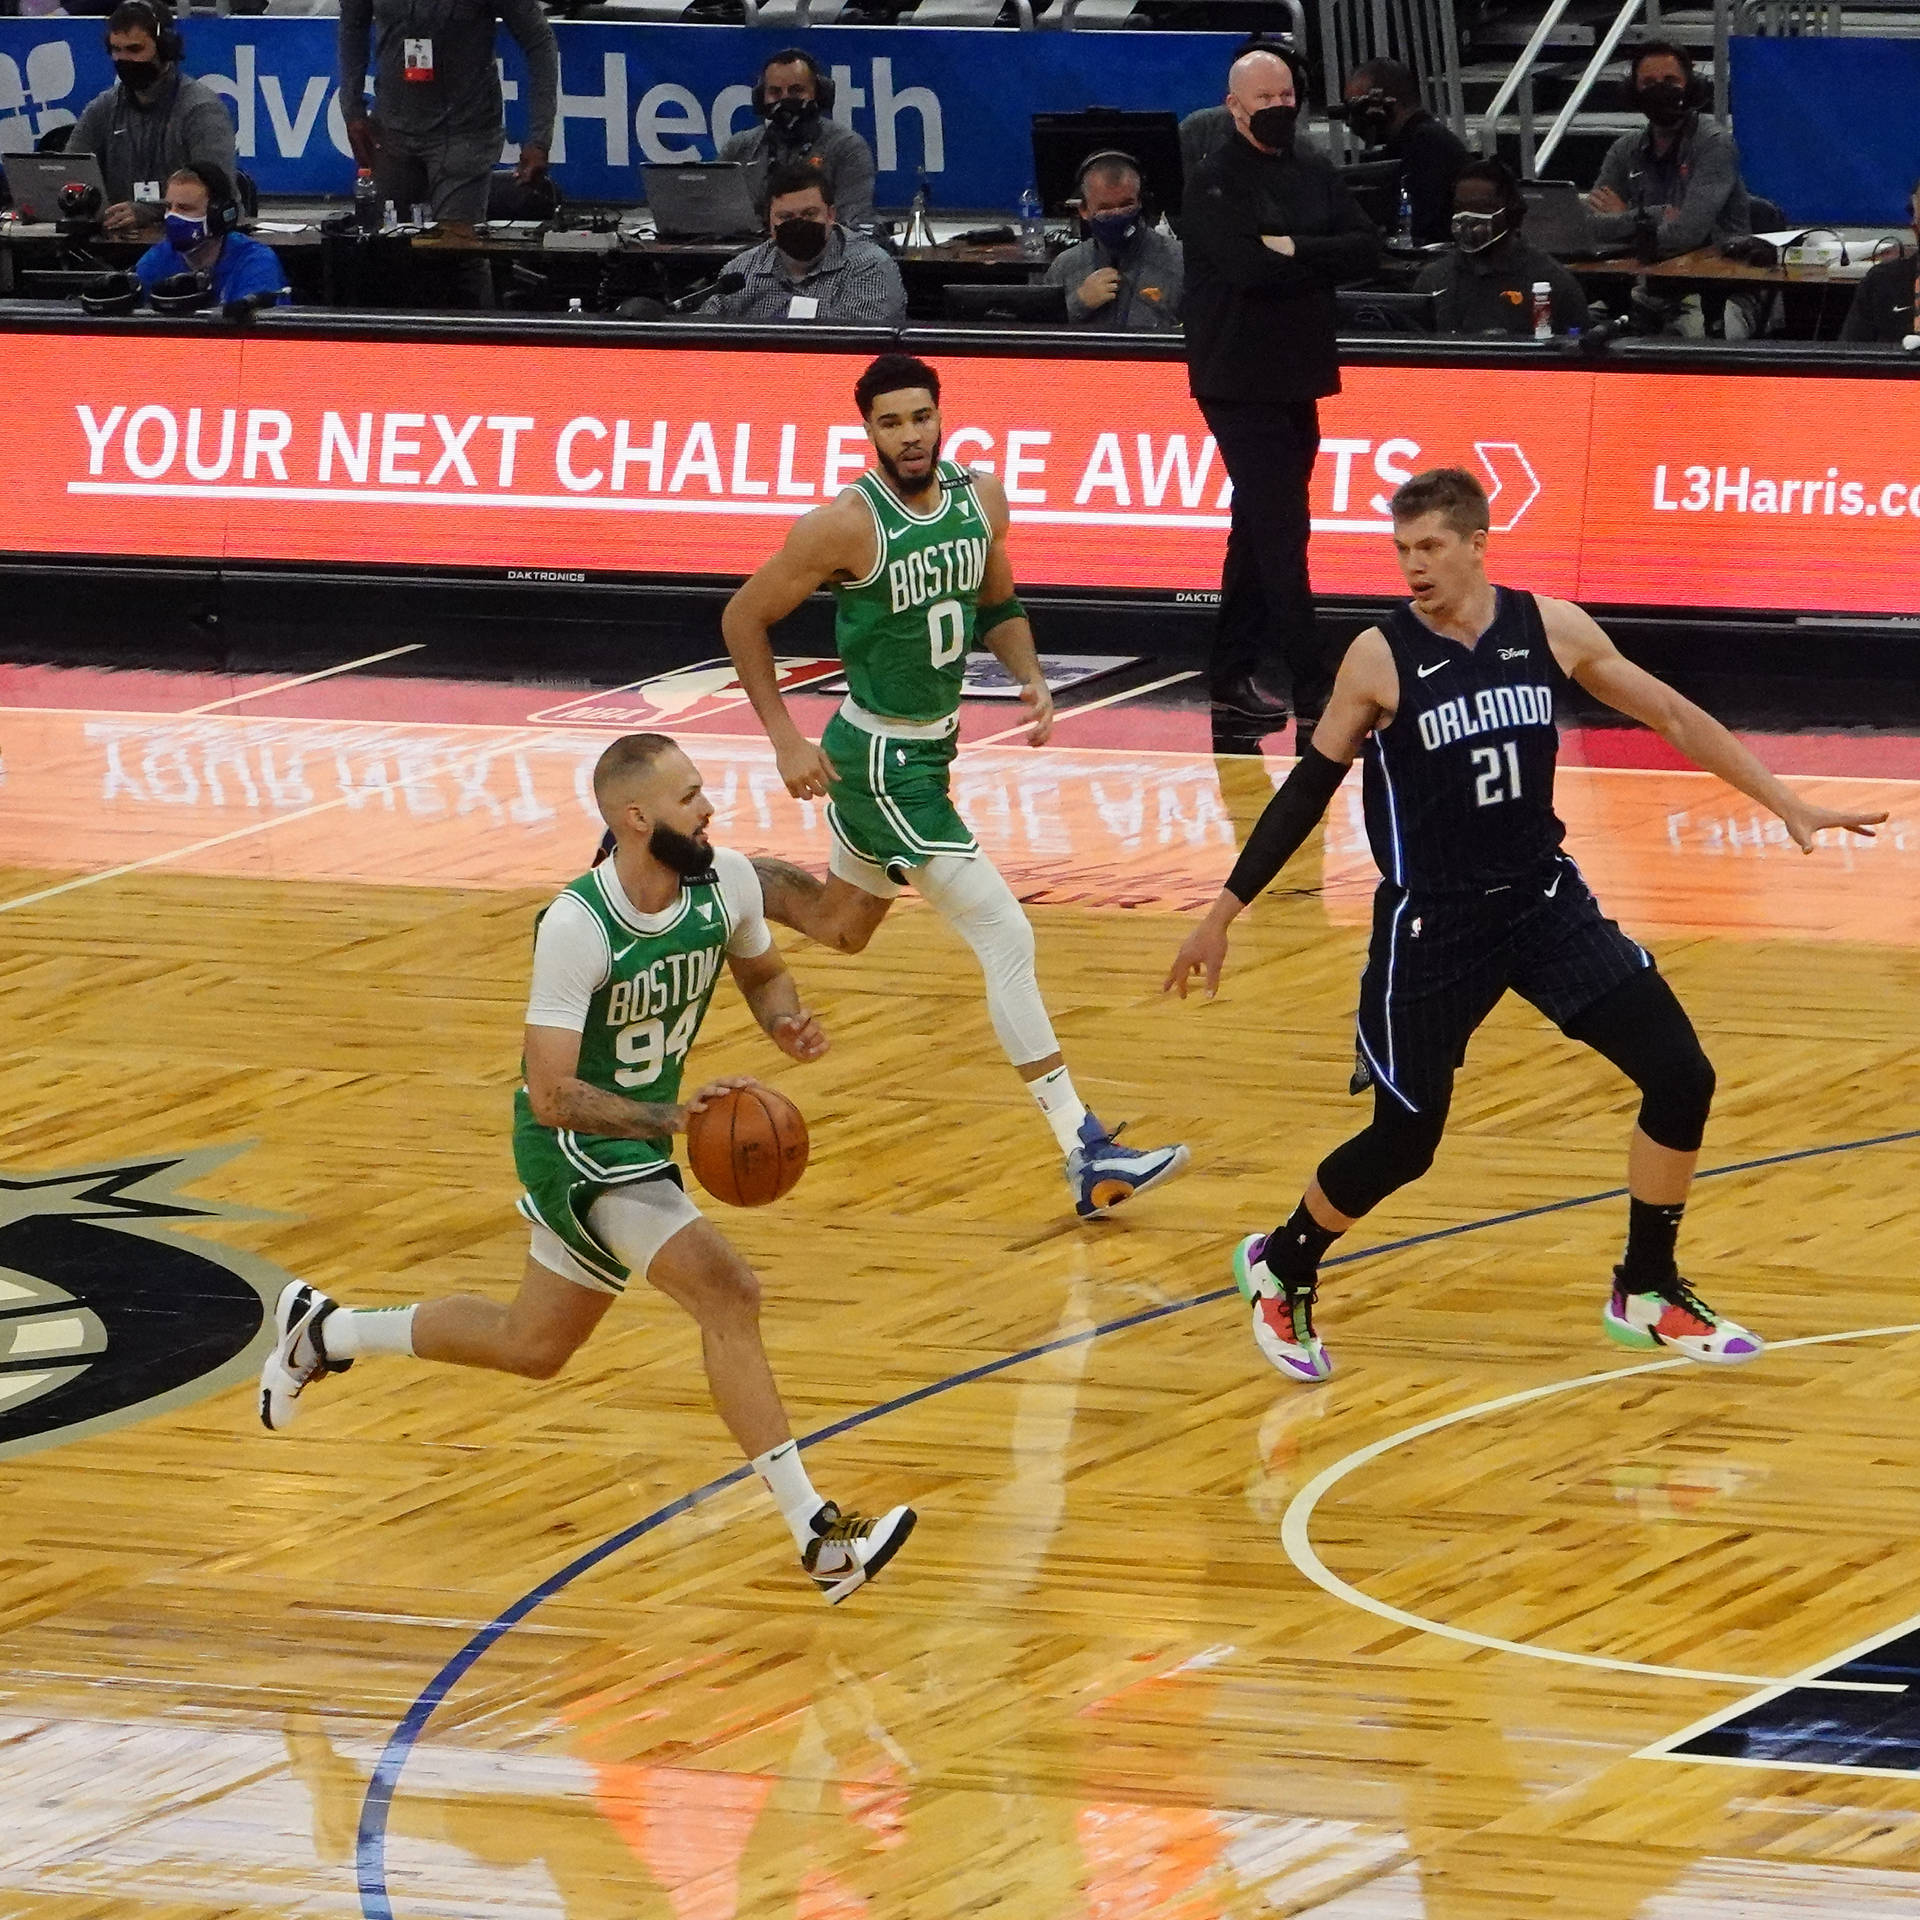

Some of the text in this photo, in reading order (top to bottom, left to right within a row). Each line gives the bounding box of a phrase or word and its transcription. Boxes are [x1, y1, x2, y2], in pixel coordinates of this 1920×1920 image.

[75, 404, 1422, 515] YOUR NEXT CHALLEGE AWTS
[1652, 464, 1920, 518] L3Harris.c
[507, 570, 585, 582] DAKTRONICS
[888, 537, 987, 614] BOSTON
[926, 599, 965, 670] 0
[555, 706, 647, 722] NBA
[1418, 685, 1553, 752] ORLANDO
[1469, 741, 1524, 808] 21
[606, 944, 722, 1026] BOSTON
[614, 1001, 700, 1088] 94
